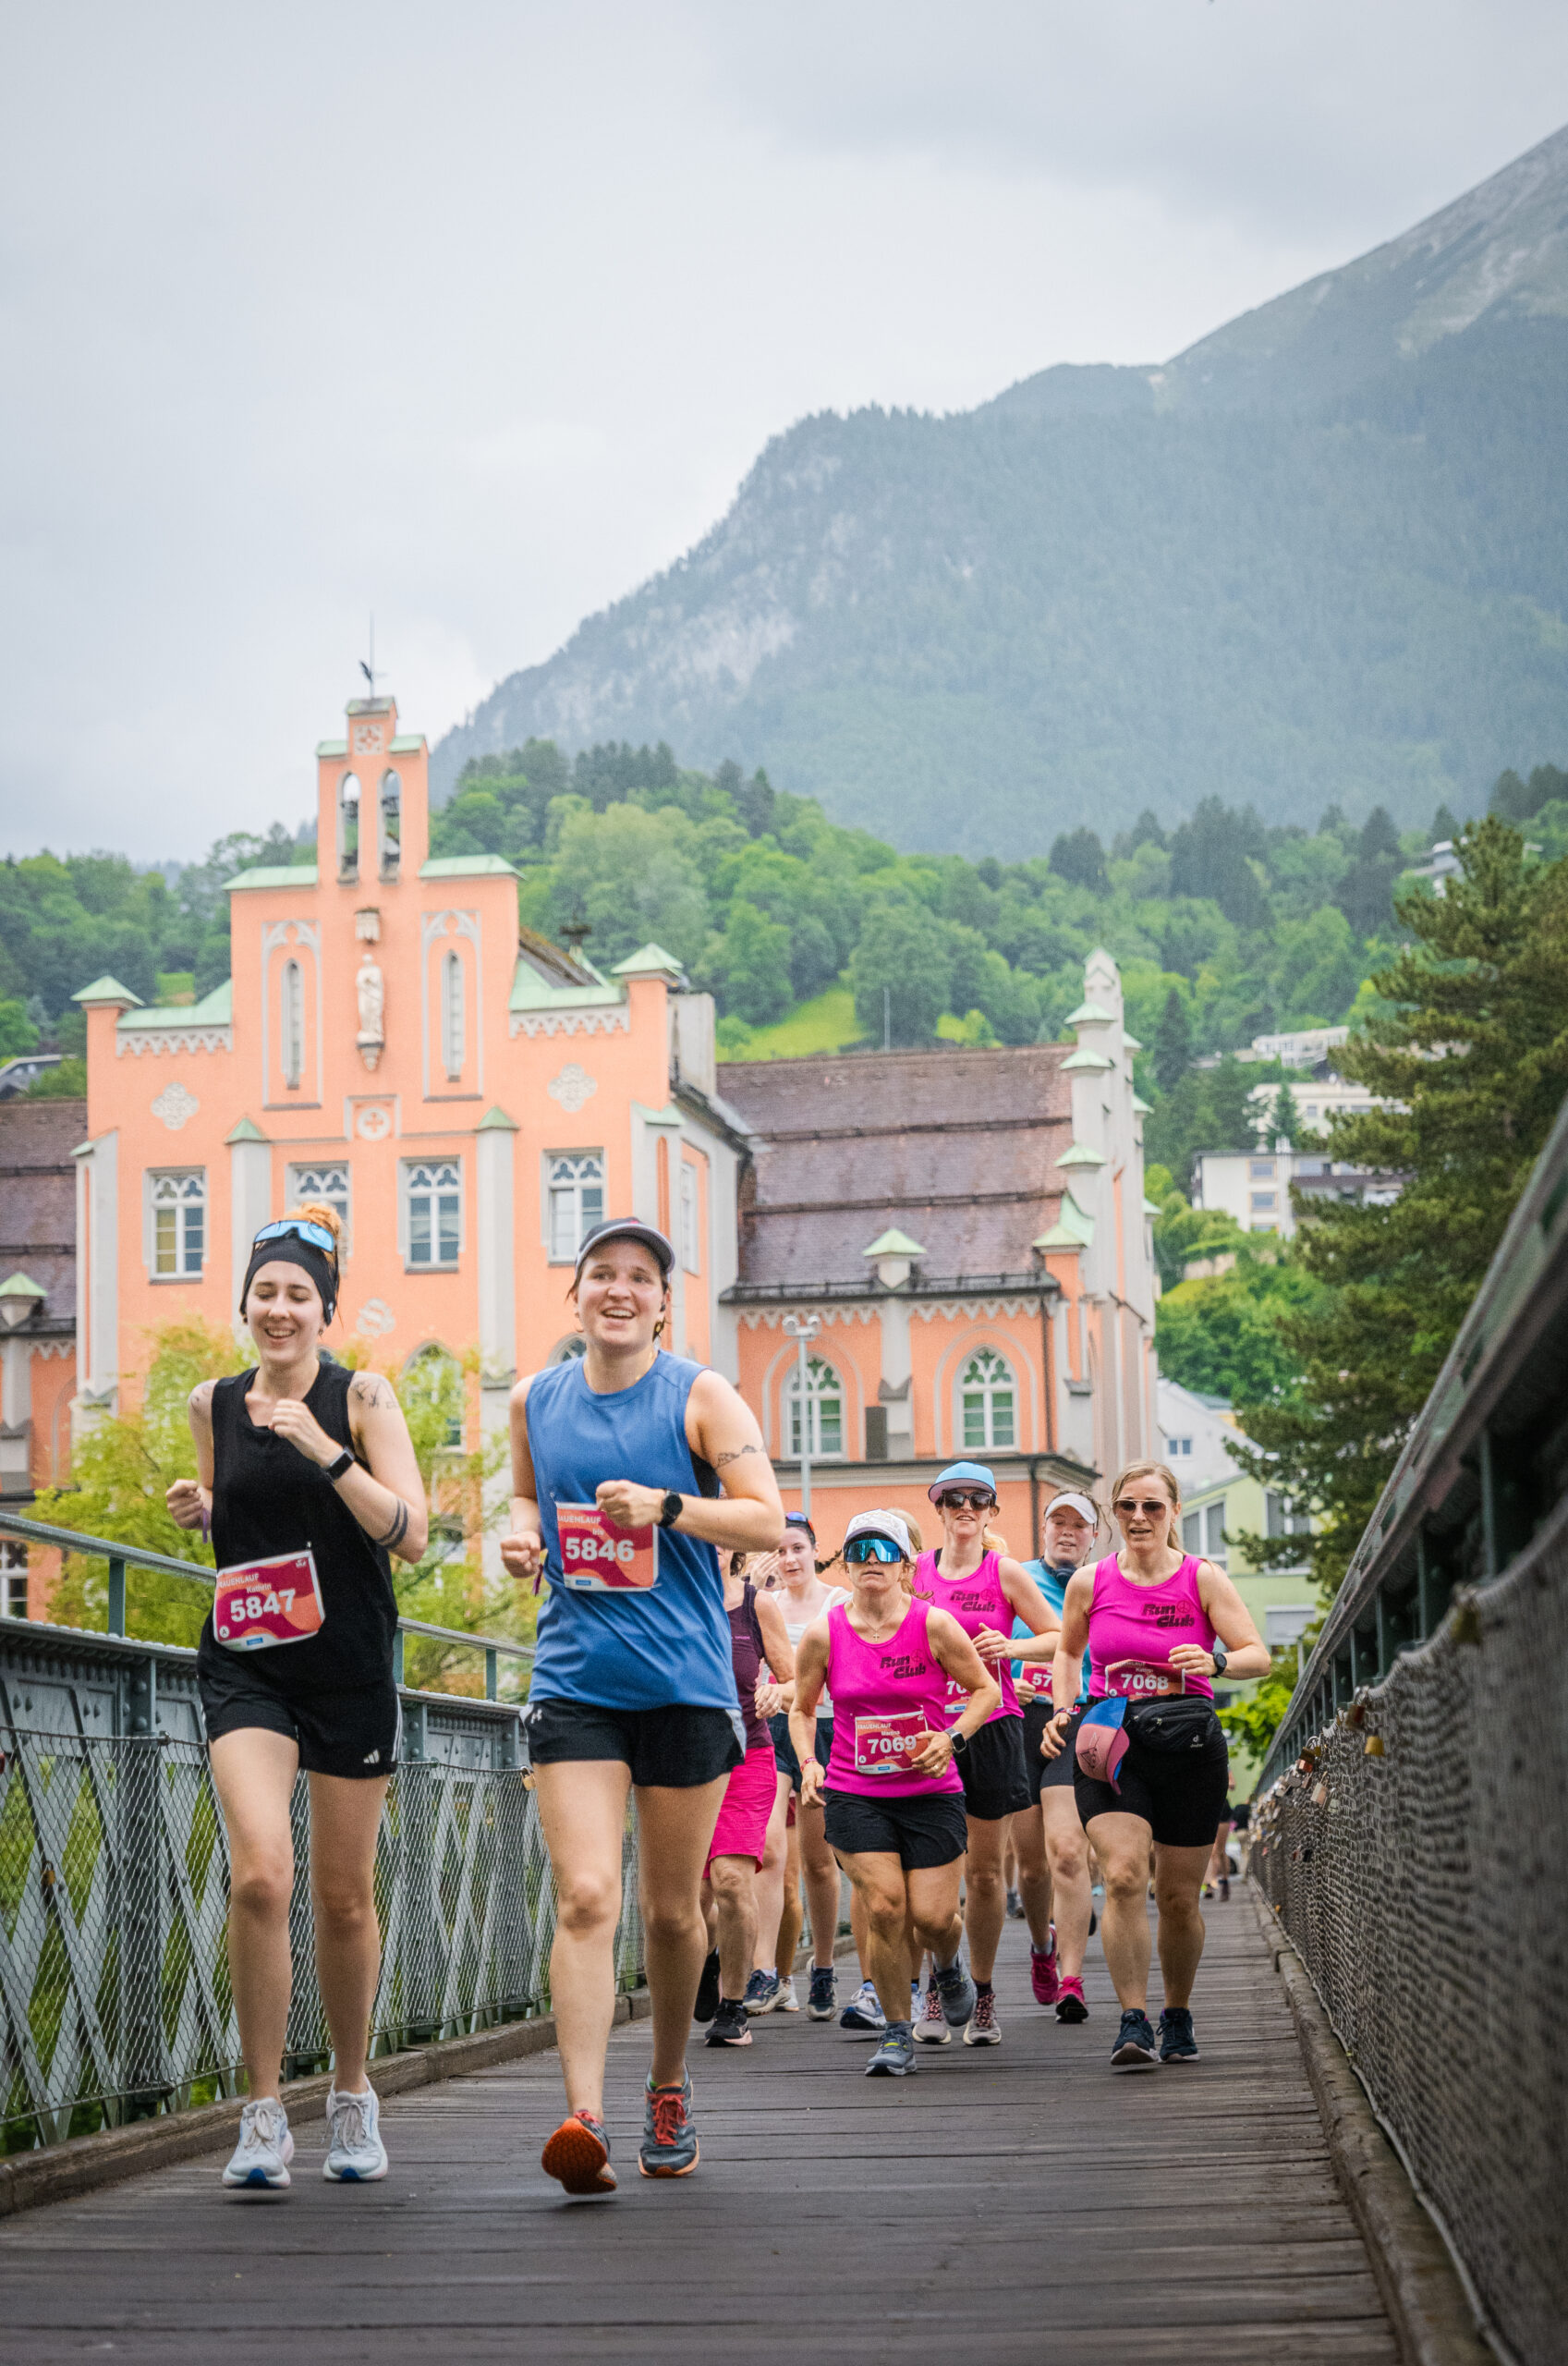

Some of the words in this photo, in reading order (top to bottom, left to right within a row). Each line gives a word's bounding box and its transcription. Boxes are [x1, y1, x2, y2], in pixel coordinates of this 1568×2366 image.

[565, 1537, 635, 1563] 5846
[246, 1583, 272, 1593] Kathrin
[950, 1591, 979, 1601] Run
[230, 1589, 296, 1623] 5847
[961, 1601, 995, 1612] Club
[1142, 1604, 1175, 1616] Run
[1157, 1615, 1195, 1628] Club
[880, 1655, 910, 1668] Run
[893, 1663, 926, 1678] Club
[1121, 1674, 1169, 1689] 7068
[868, 1735, 917, 1754] 7069
